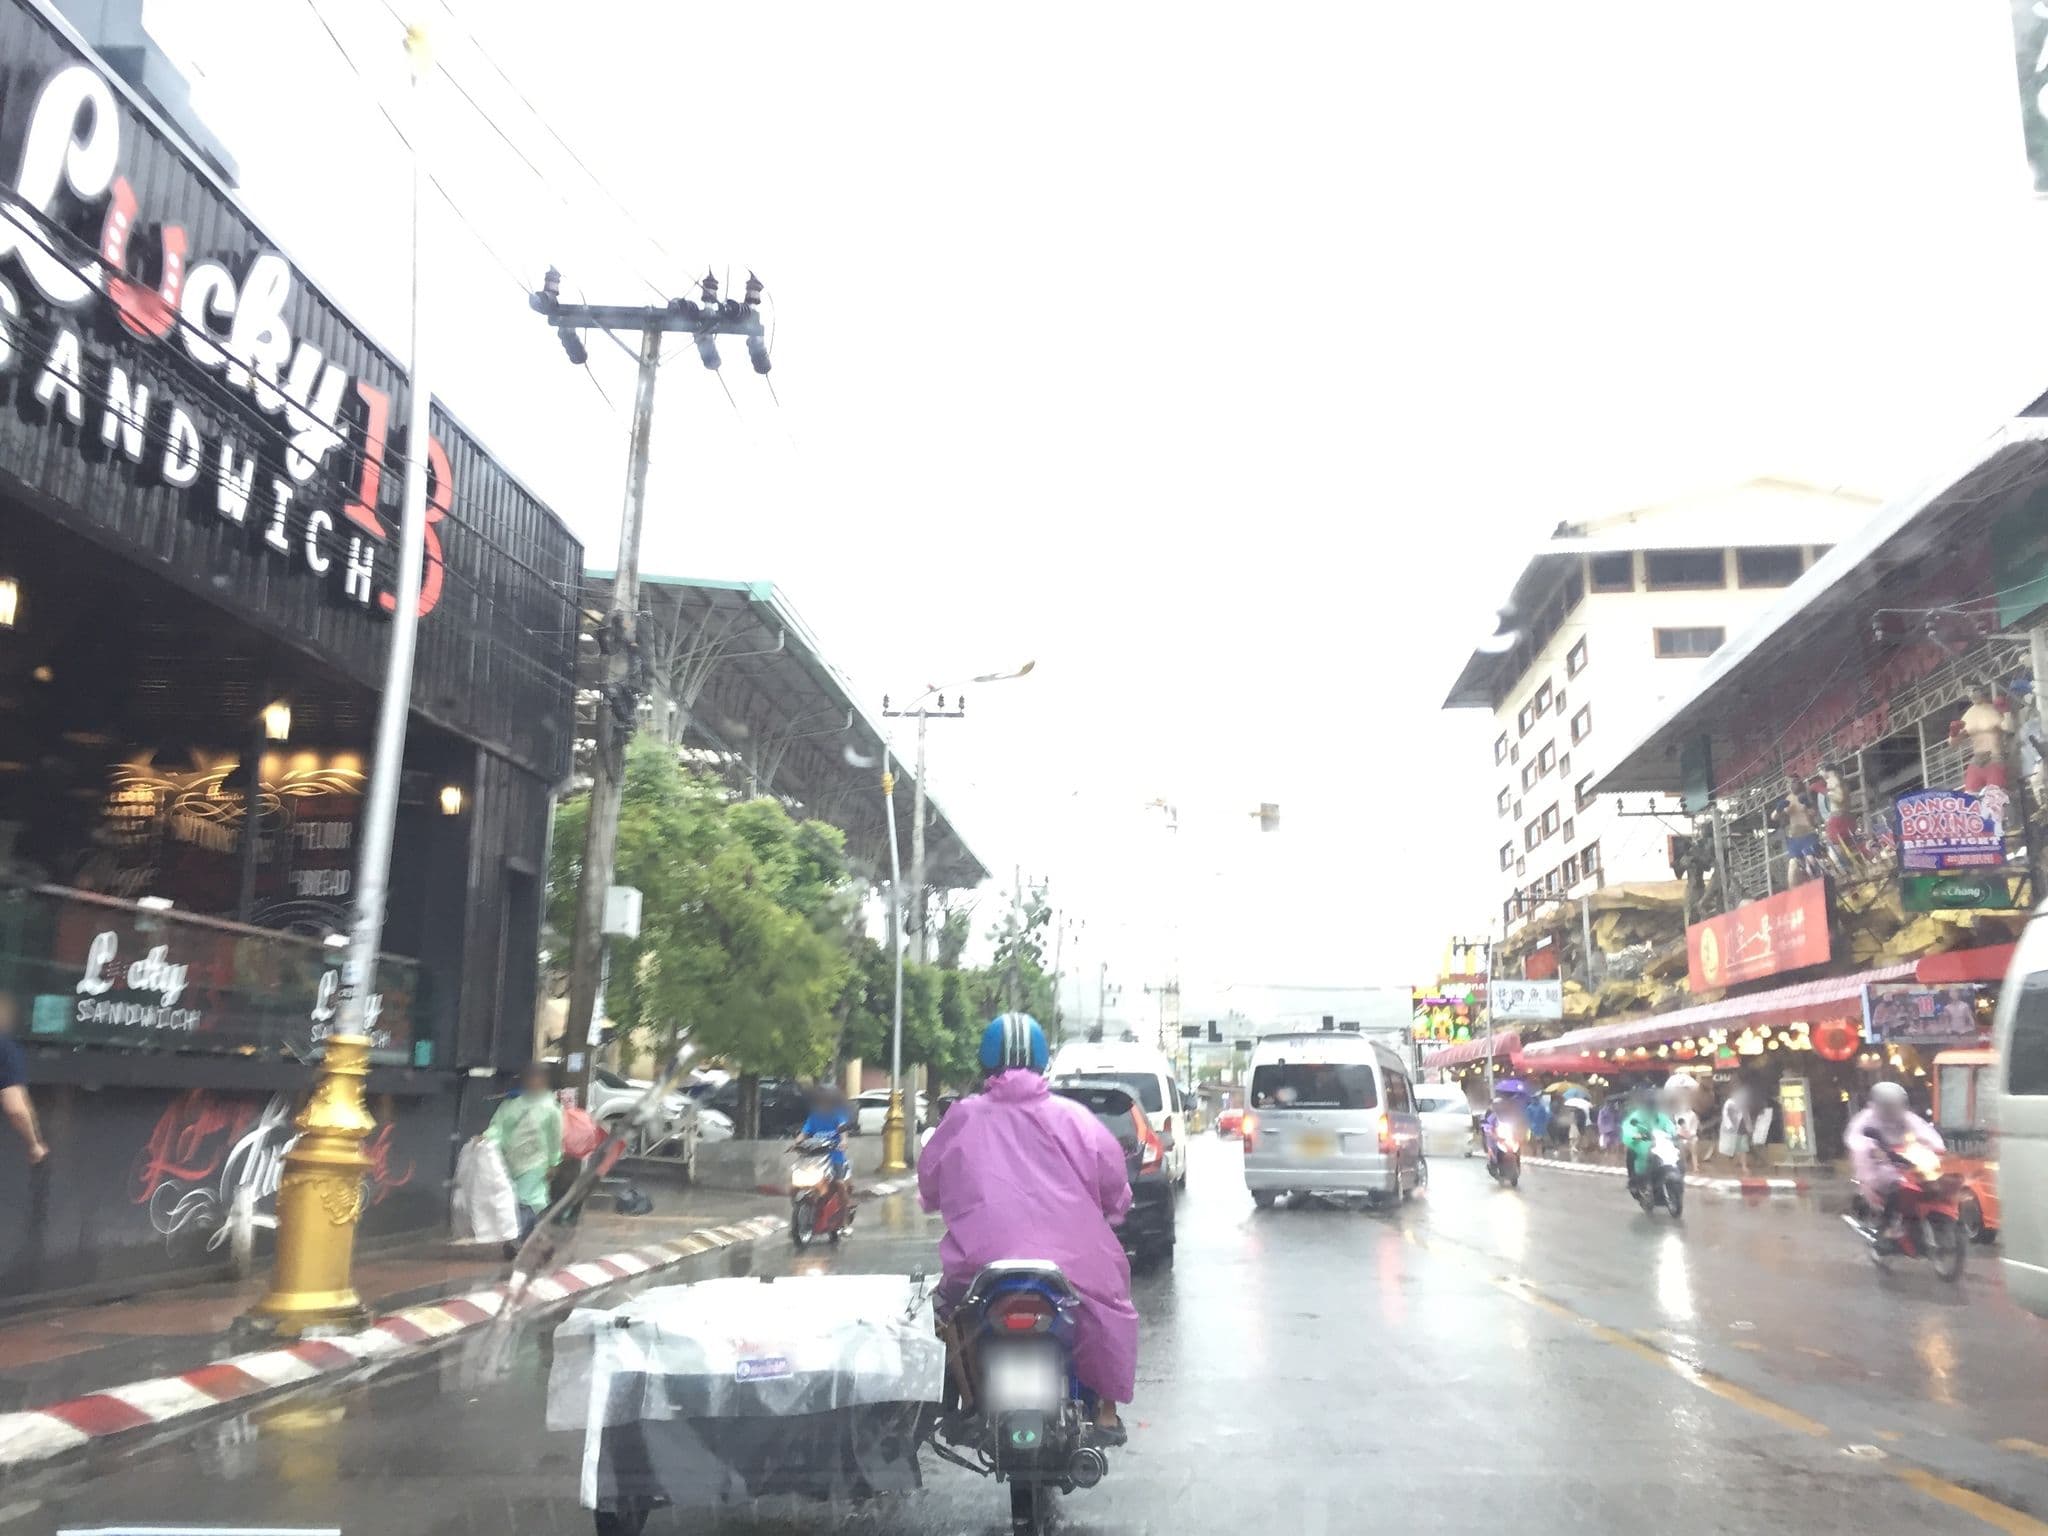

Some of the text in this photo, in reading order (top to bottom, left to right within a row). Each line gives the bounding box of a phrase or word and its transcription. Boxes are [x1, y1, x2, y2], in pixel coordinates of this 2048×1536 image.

[1897, 796, 1982, 819] BANGLA
[1901, 812, 1985, 836] BOXING
[1903, 840, 1947, 850] REAL
[1947, 887, 1981, 898] Chang
